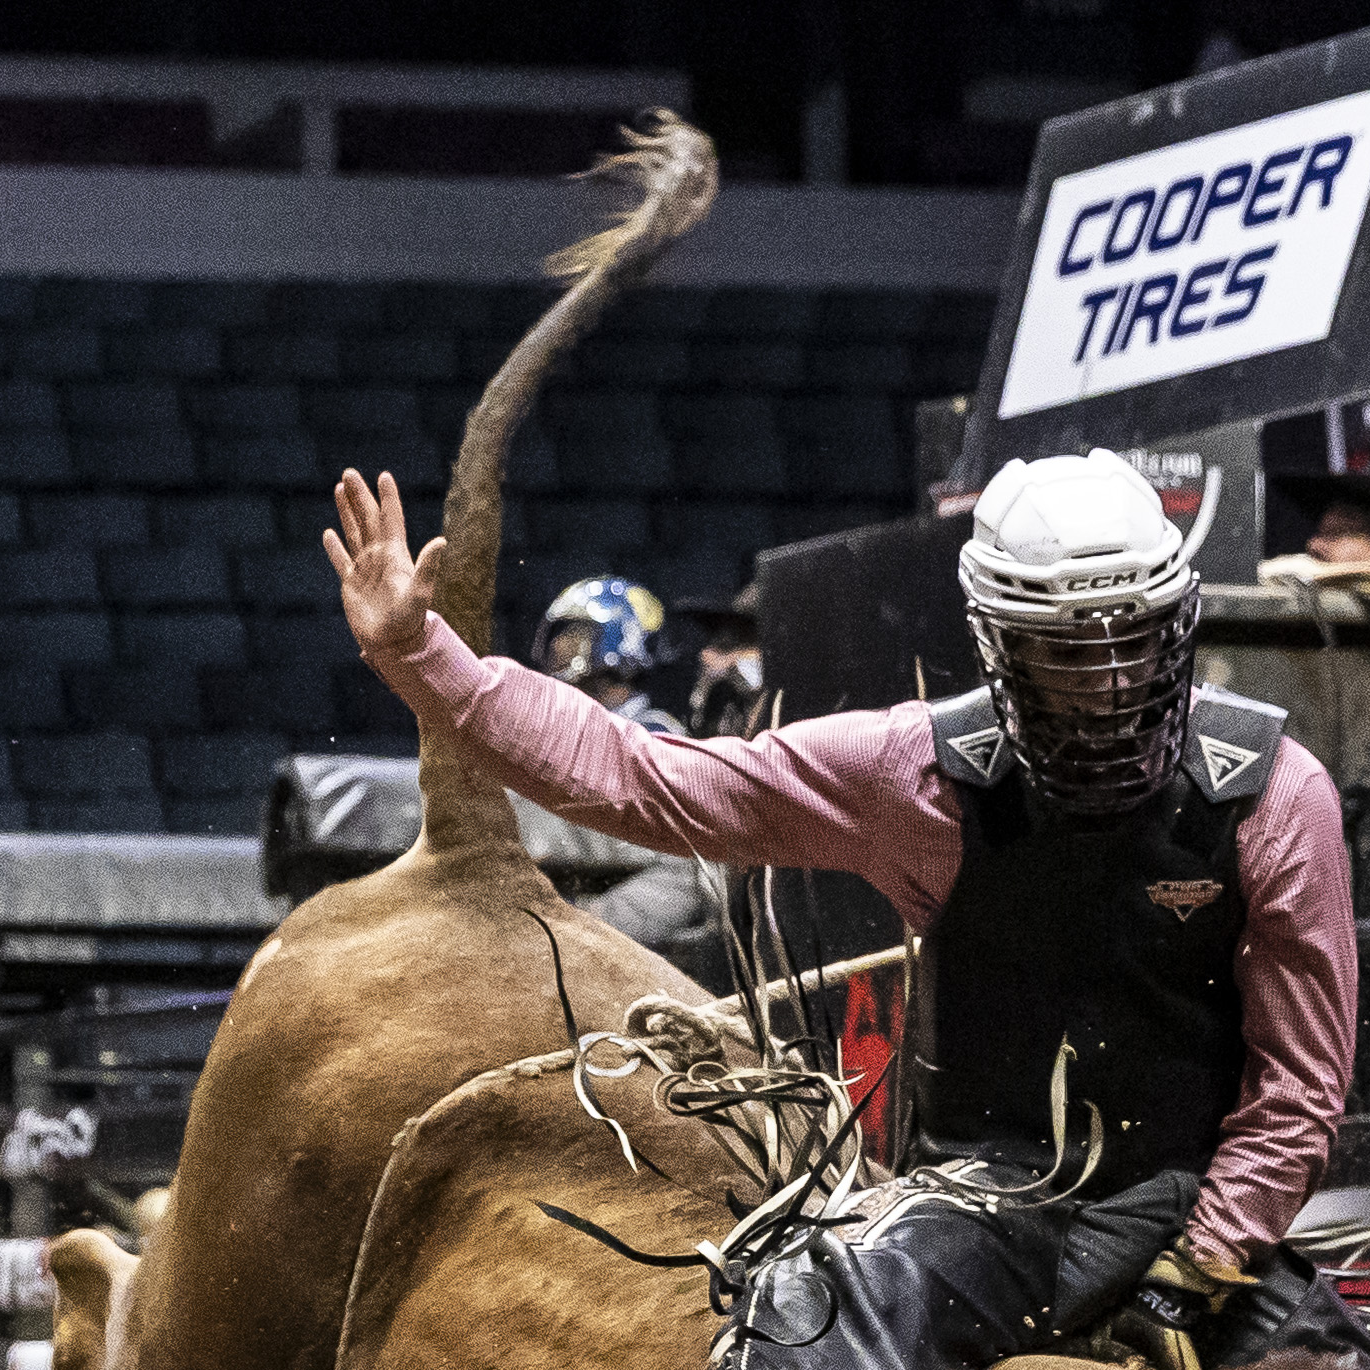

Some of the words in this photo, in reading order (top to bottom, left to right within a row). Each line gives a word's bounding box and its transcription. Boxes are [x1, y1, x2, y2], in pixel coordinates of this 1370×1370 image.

[1058, 134, 1354, 278] COOPER
[1076, 243, 1279, 364] TIRES
[1067, 571, 1137, 592] CCM
